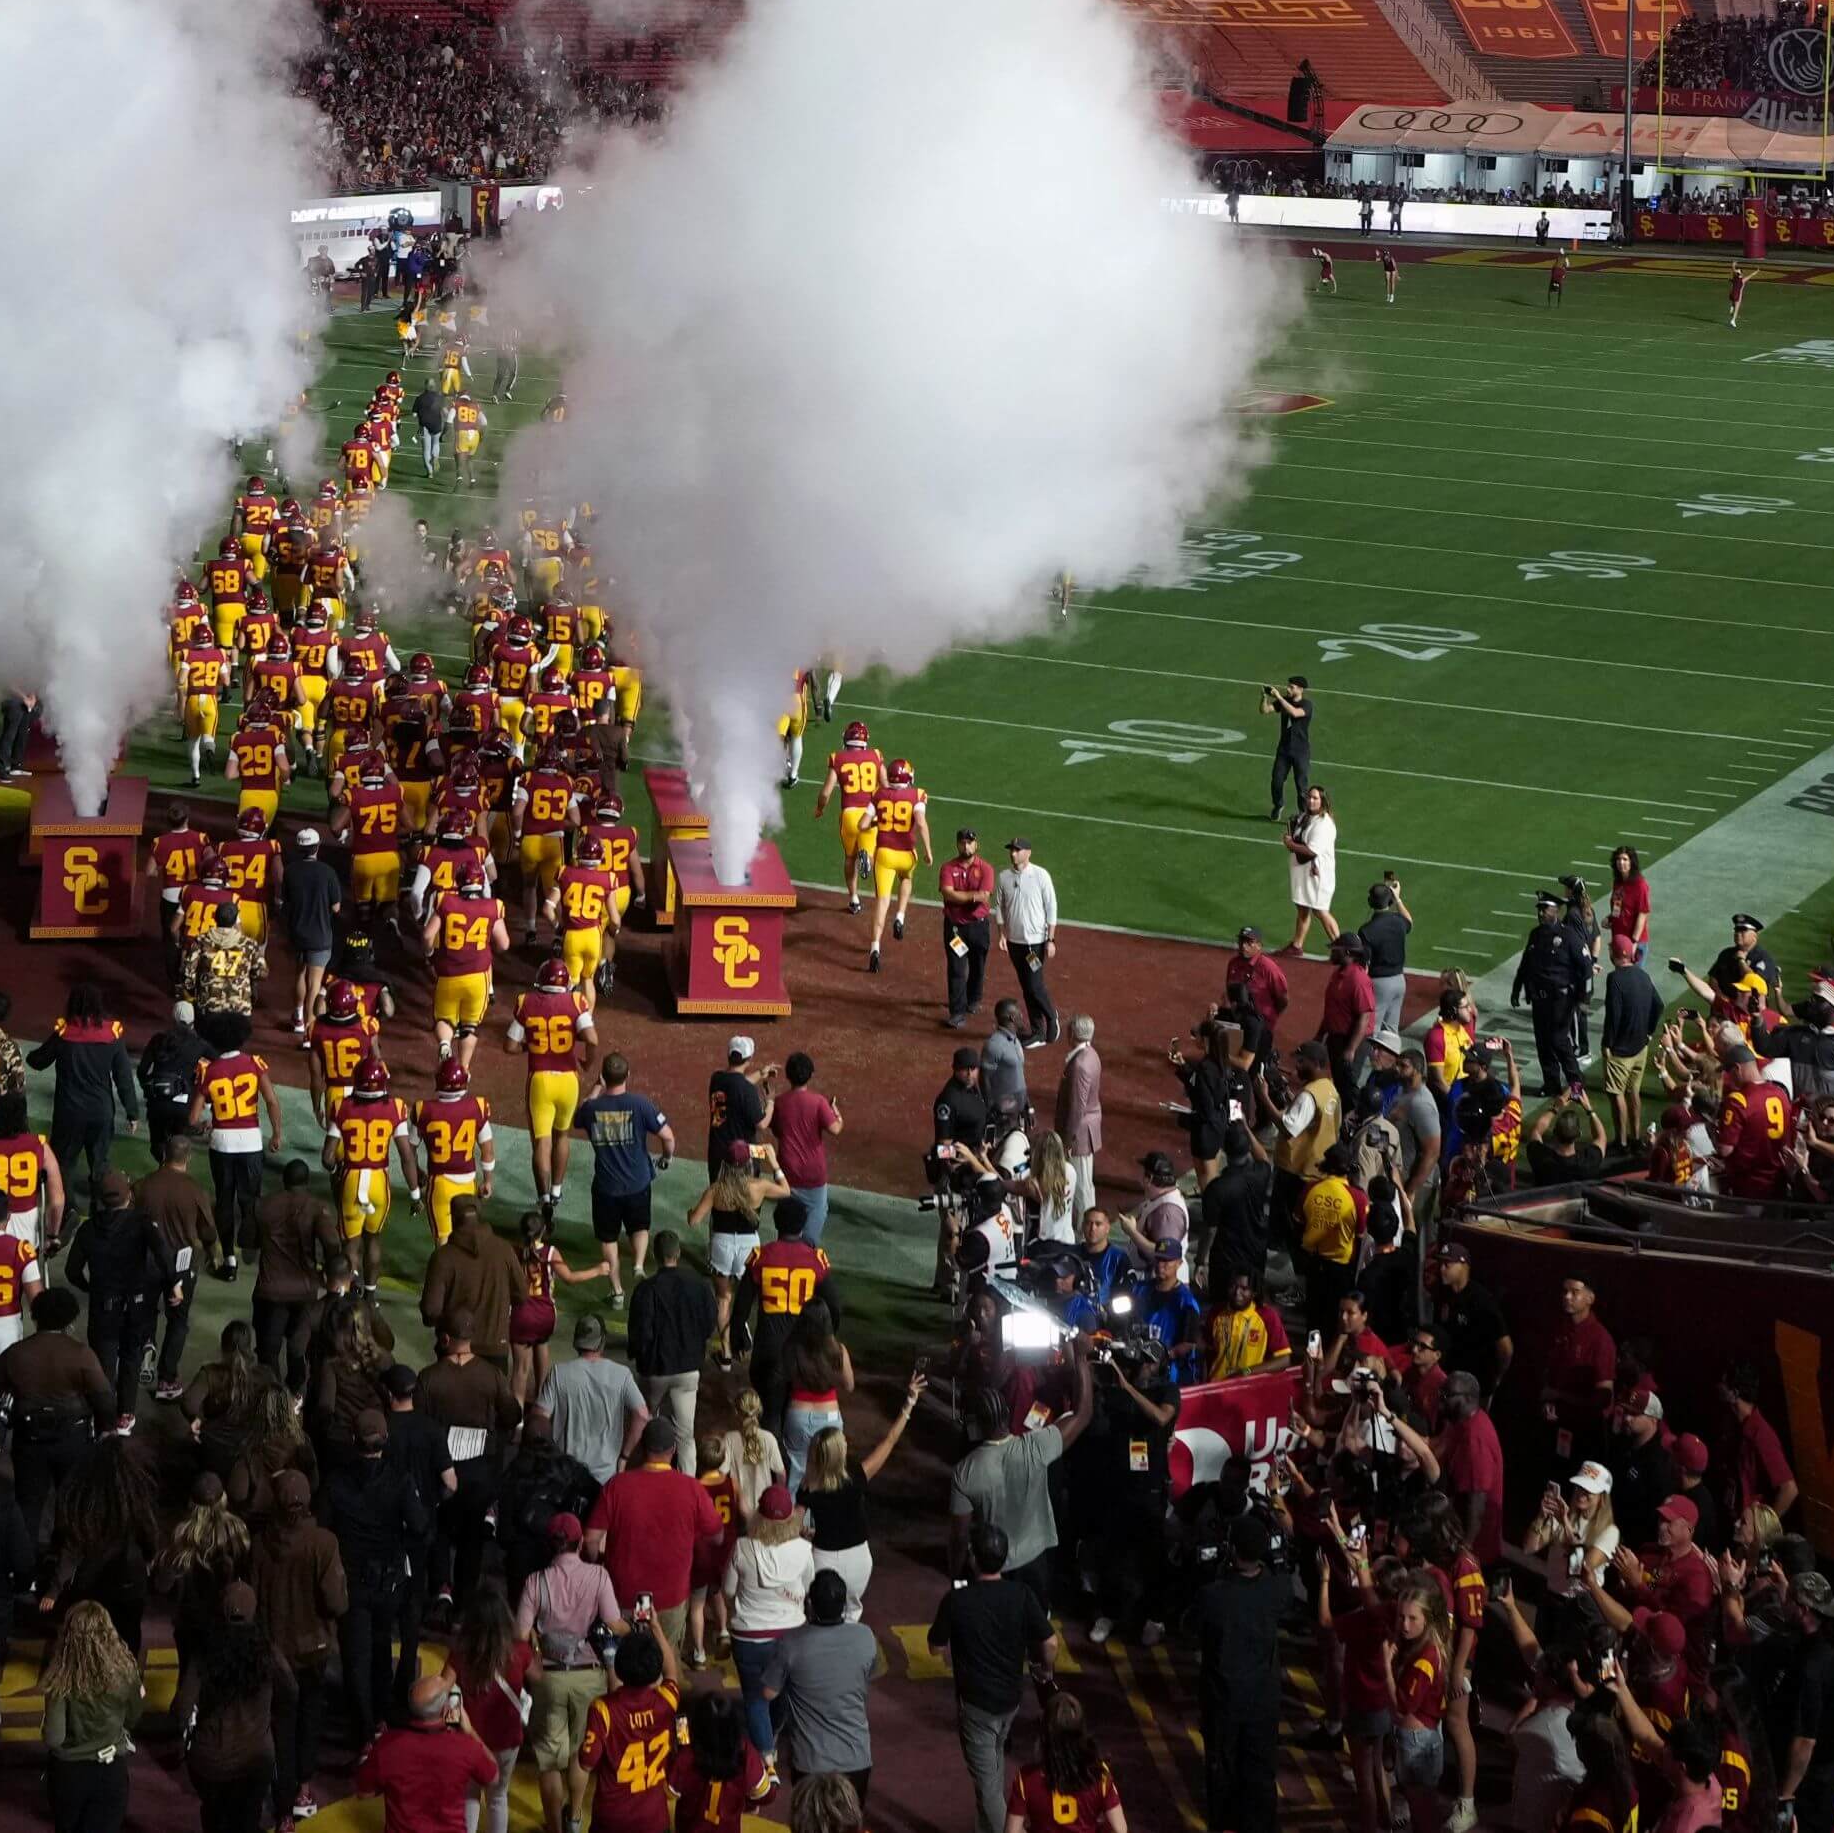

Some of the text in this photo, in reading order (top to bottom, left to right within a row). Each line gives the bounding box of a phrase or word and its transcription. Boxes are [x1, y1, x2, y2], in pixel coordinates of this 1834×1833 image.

[1482, 26, 1556, 40] 1965
[1692, 92, 1751, 110] FRANK
[1570, 121, 1701, 141] Audi
[380, 427, 388, 445] 1
[346, 448, 369, 469] 78
[246, 505, 273, 526] 23
[1675, 492, 1796, 517] 40
[531, 529, 560, 551] 56
[1517, 550, 1657, 580] 30
[176, 615, 200, 643] 30
[246, 622, 271, 650] 31
[546, 615, 571, 642] 15
[1317, 623, 1481, 662] 20
[294, 645, 327, 668] 70
[189, 661, 220, 687] 28
[499, 661, 528, 690] 49
[578, 681, 604, 709] 18
[1060, 718, 1247, 764] 10
[237, 744, 272, 776] 29
[841, 762, 878, 794] 38
[359, 803, 398, 835] 75
[533, 788, 569, 821] 63
[877, 800, 914, 832] 39
[63, 846, 110, 915] SC
[166, 847, 198, 882] 41
[225, 853, 267, 889] 54
[563, 881, 605, 920] 46
[445, 912, 491, 951] 64
[211, 950, 244, 977] 47
[713, 915, 761, 989] SC
[524, 1014, 572, 1054] 36
[322, 1037, 362, 1079] 16
[208, 1072, 259, 1121] 82
[1723, 1108, 1734, 1127] 9
[1765, 1096, 1784, 1139] 9
[341, 1118, 394, 1163] 38
[425, 1119, 476, 1164] 34
[1312, 1195, 1342, 1210] CSC
[761, 1267, 816, 1315] 50
[629, 1712, 655, 1729] LOTT
[617, 1730, 670, 1794] 42
[706, 1780, 723, 1825] 1
[1052, 1792, 1078, 1826] 6
